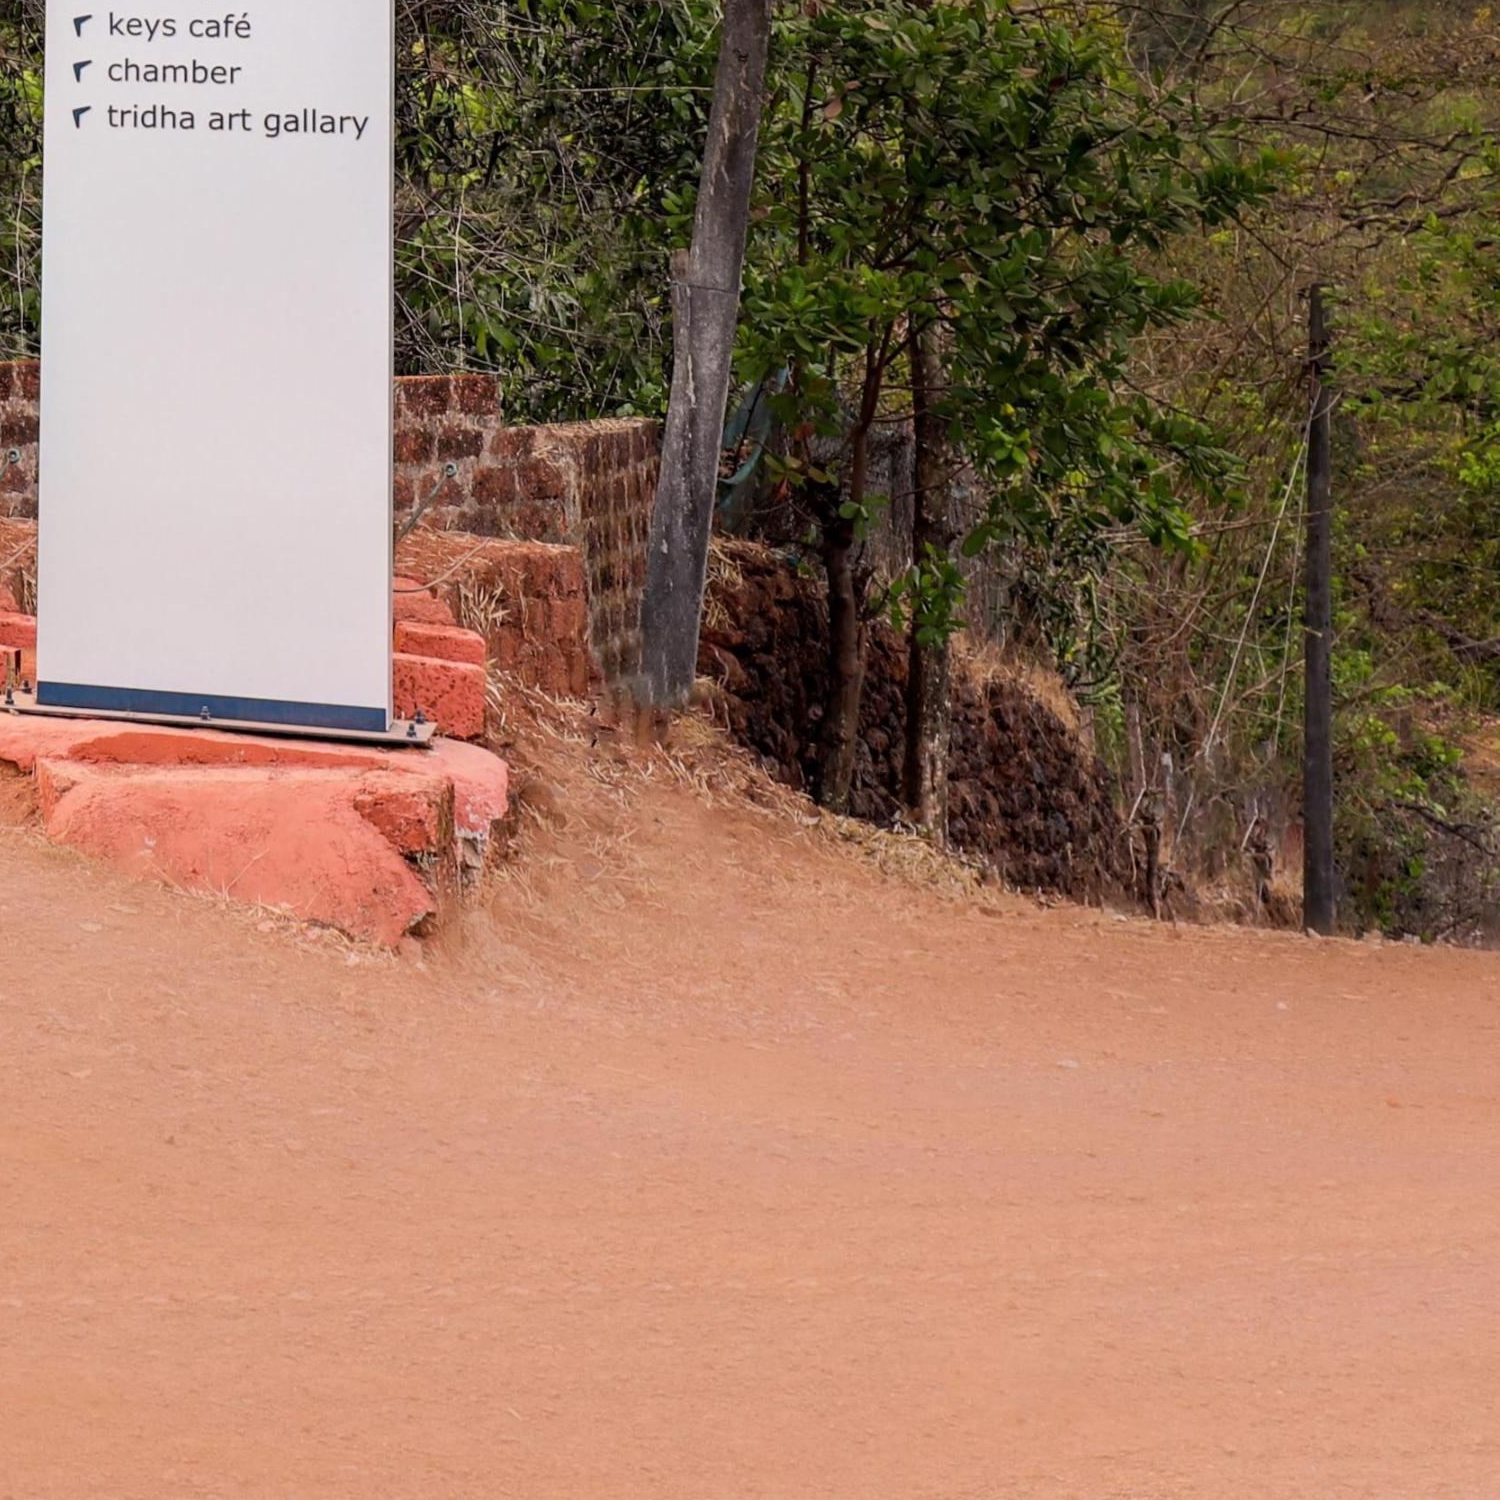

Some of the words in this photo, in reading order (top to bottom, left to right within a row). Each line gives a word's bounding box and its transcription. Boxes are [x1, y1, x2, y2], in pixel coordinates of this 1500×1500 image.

[109, 13, 176, 41] keys
[189, 13, 251, 38] café
[108, 58, 242, 84] chamber
[108, 105, 195, 129] tridha
[208, 111, 252, 131] art
[264, 109, 368, 139] gallary
